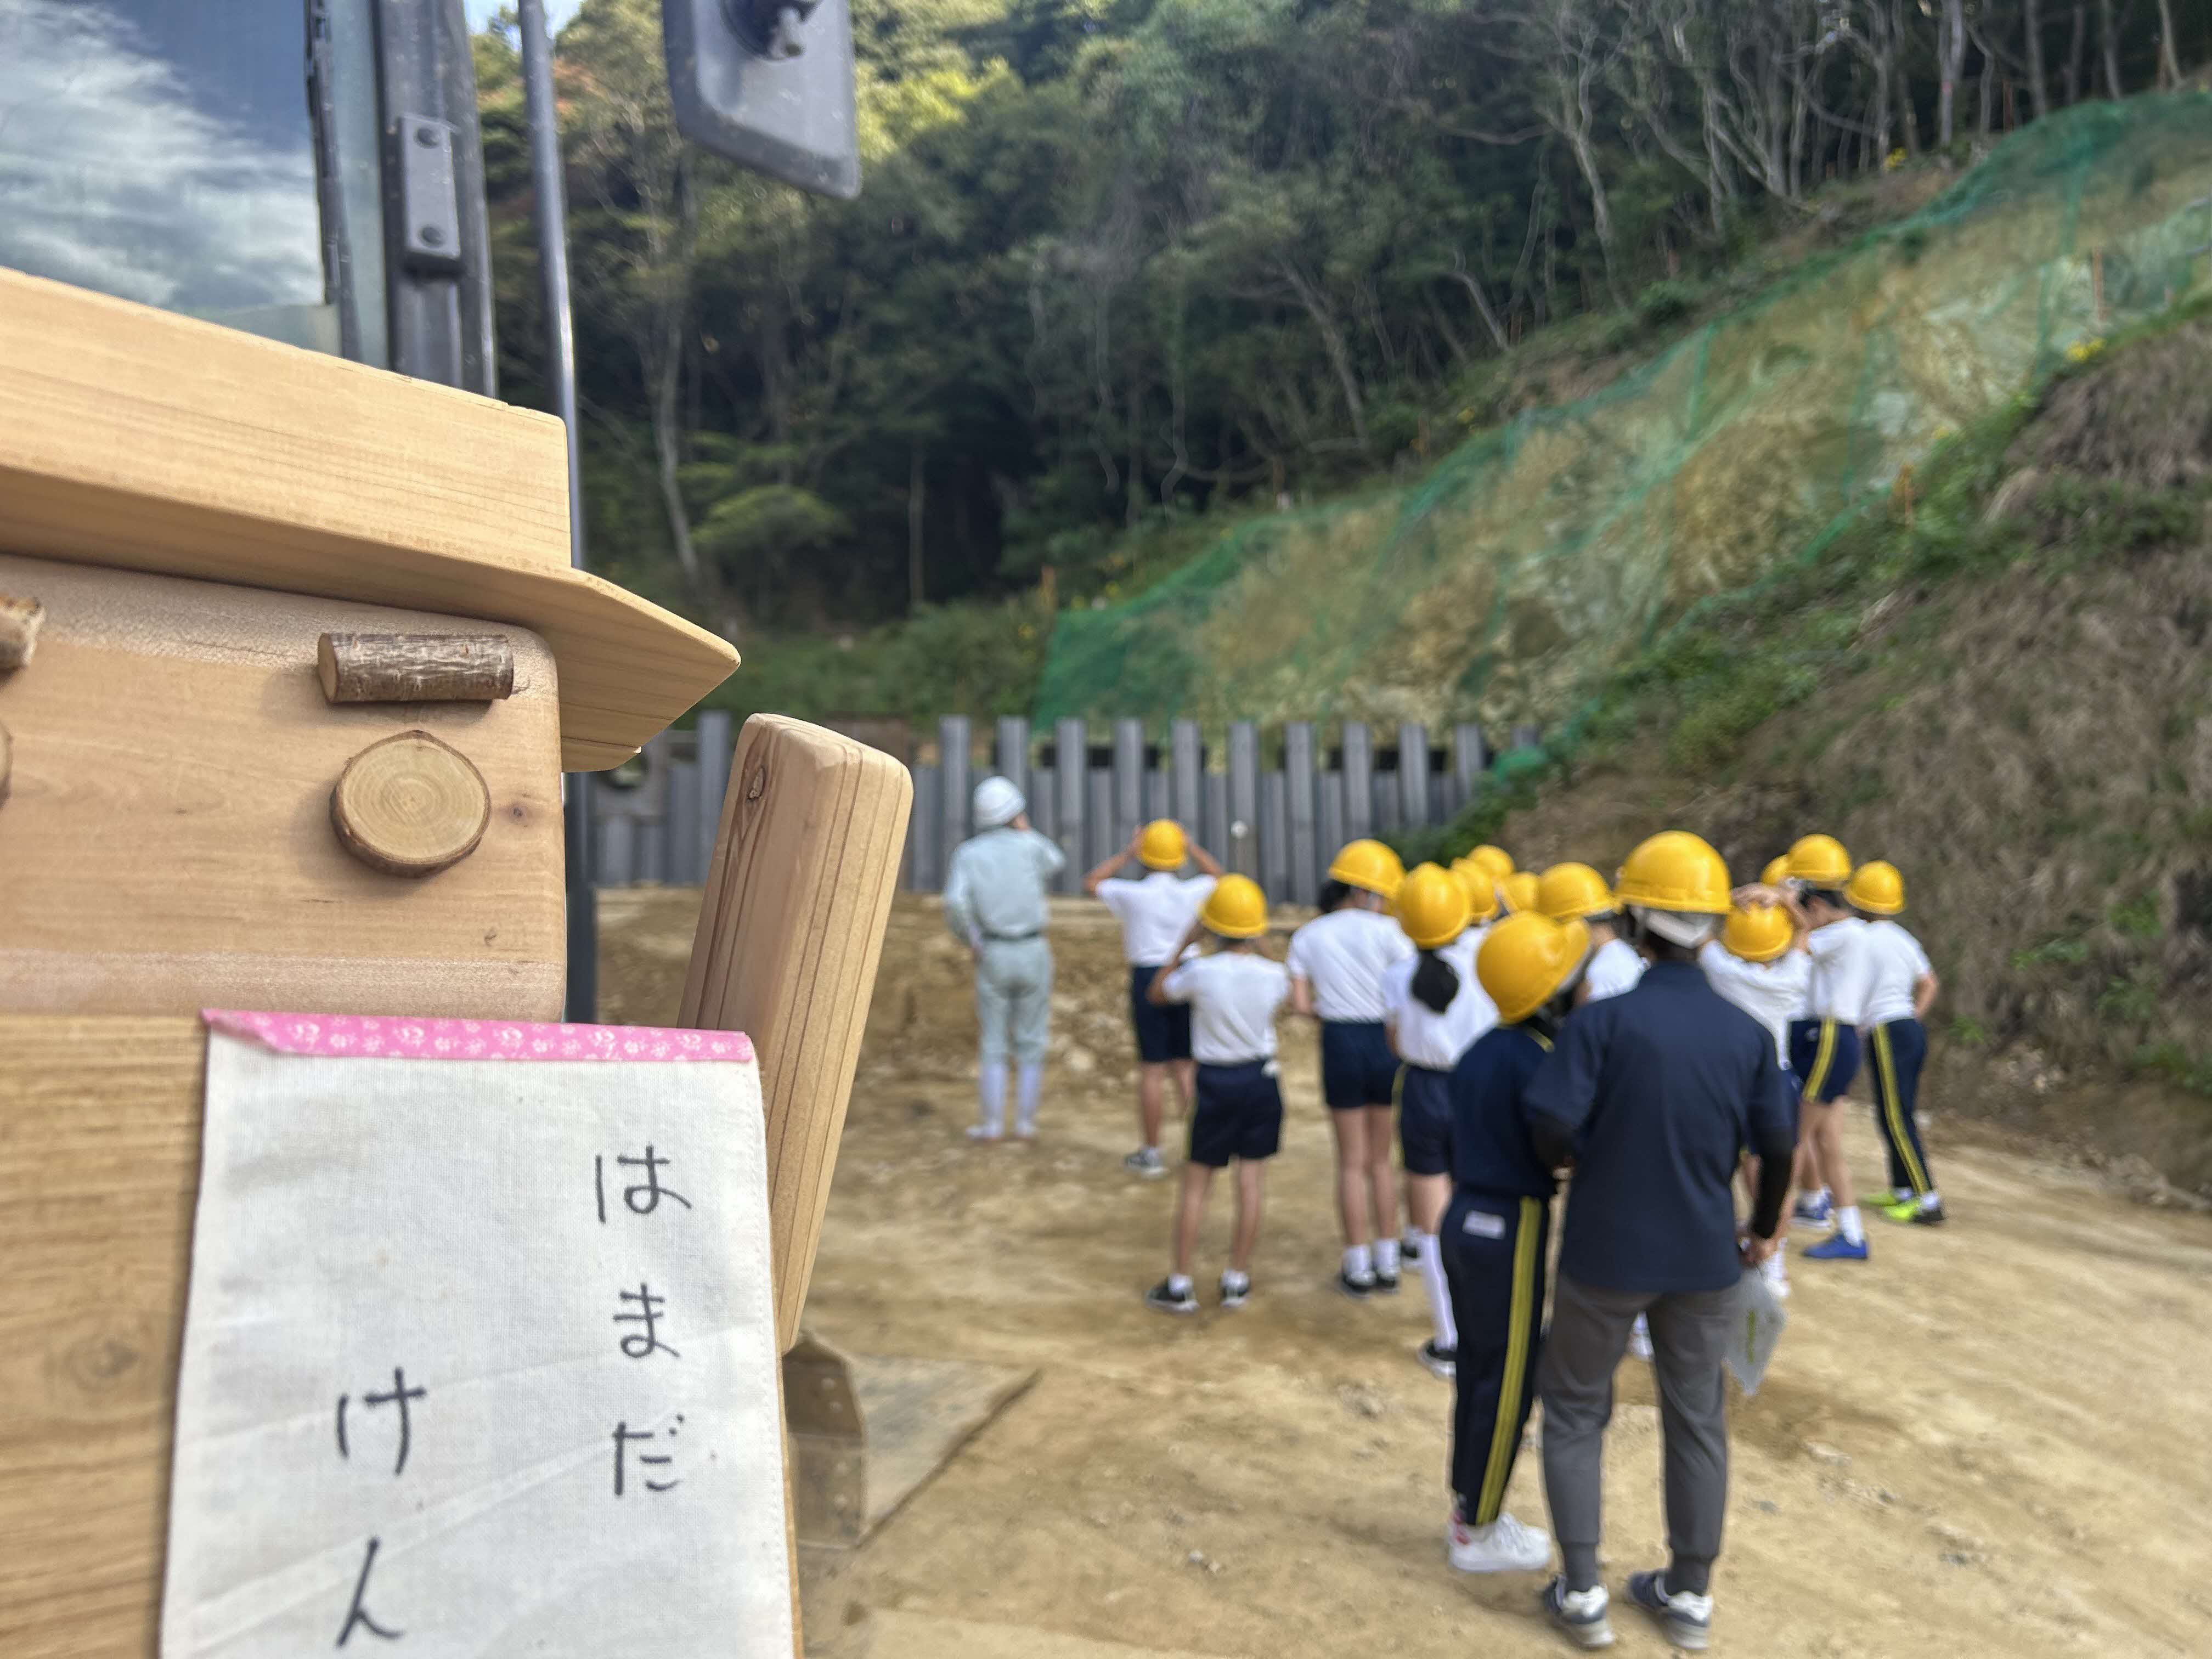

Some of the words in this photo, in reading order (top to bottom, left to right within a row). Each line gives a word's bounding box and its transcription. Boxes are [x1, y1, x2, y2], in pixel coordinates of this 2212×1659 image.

[595, 1145, 691, 1496] はまだ
[336, 1367, 426, 1647] けん
